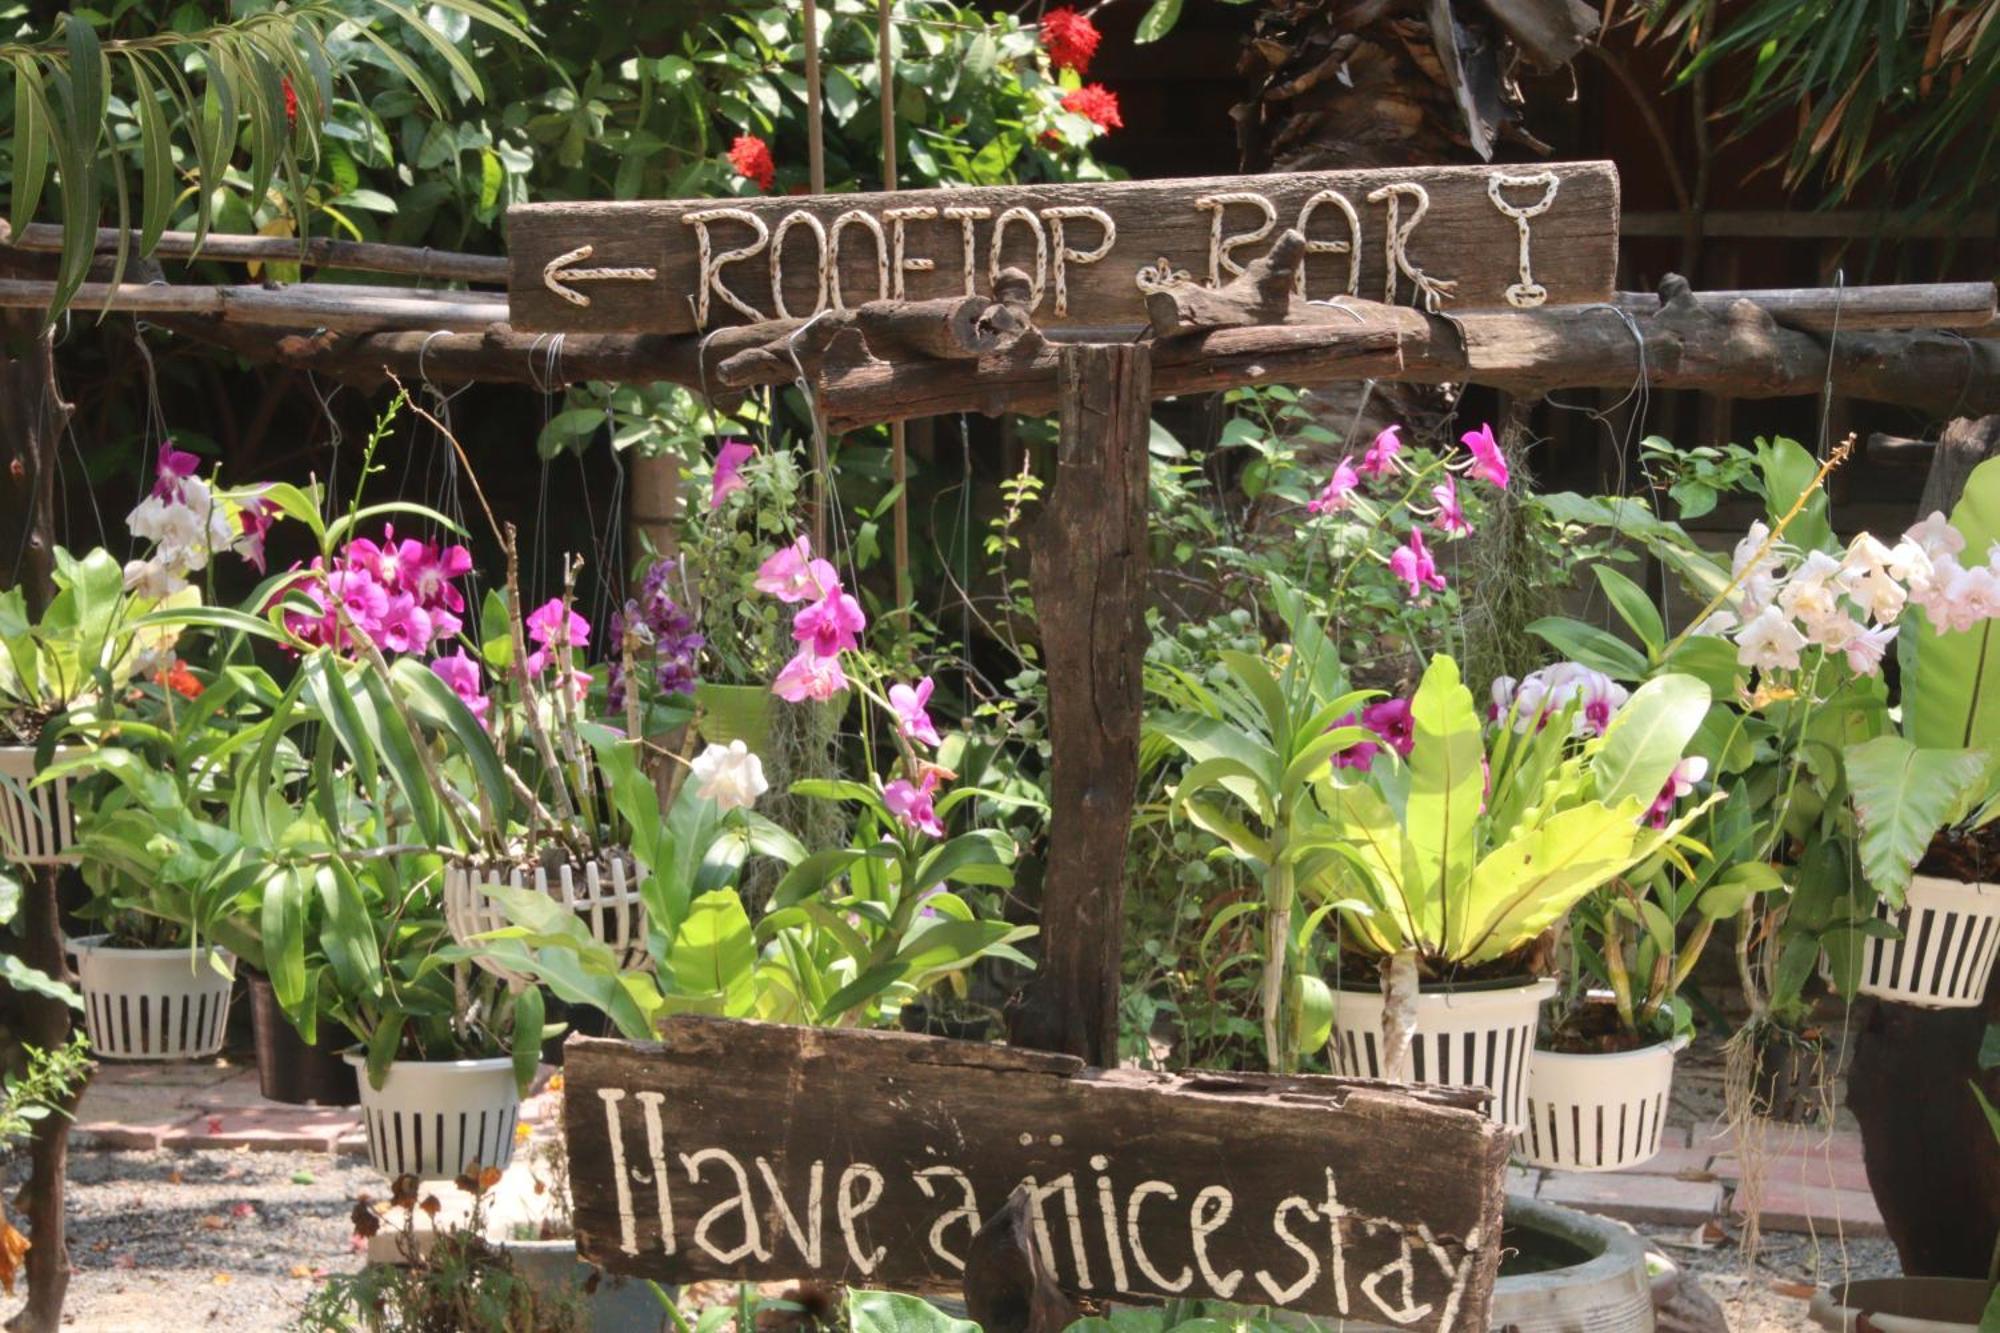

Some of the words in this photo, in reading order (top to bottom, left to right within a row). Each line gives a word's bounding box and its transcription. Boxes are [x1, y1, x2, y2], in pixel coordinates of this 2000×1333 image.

[682, 205, 1116, 328] ROOFTOP
[597, 1087, 887, 1276] Have
[1008, 1153, 1243, 1299] nice
[1256, 1166, 1480, 1333] stay
